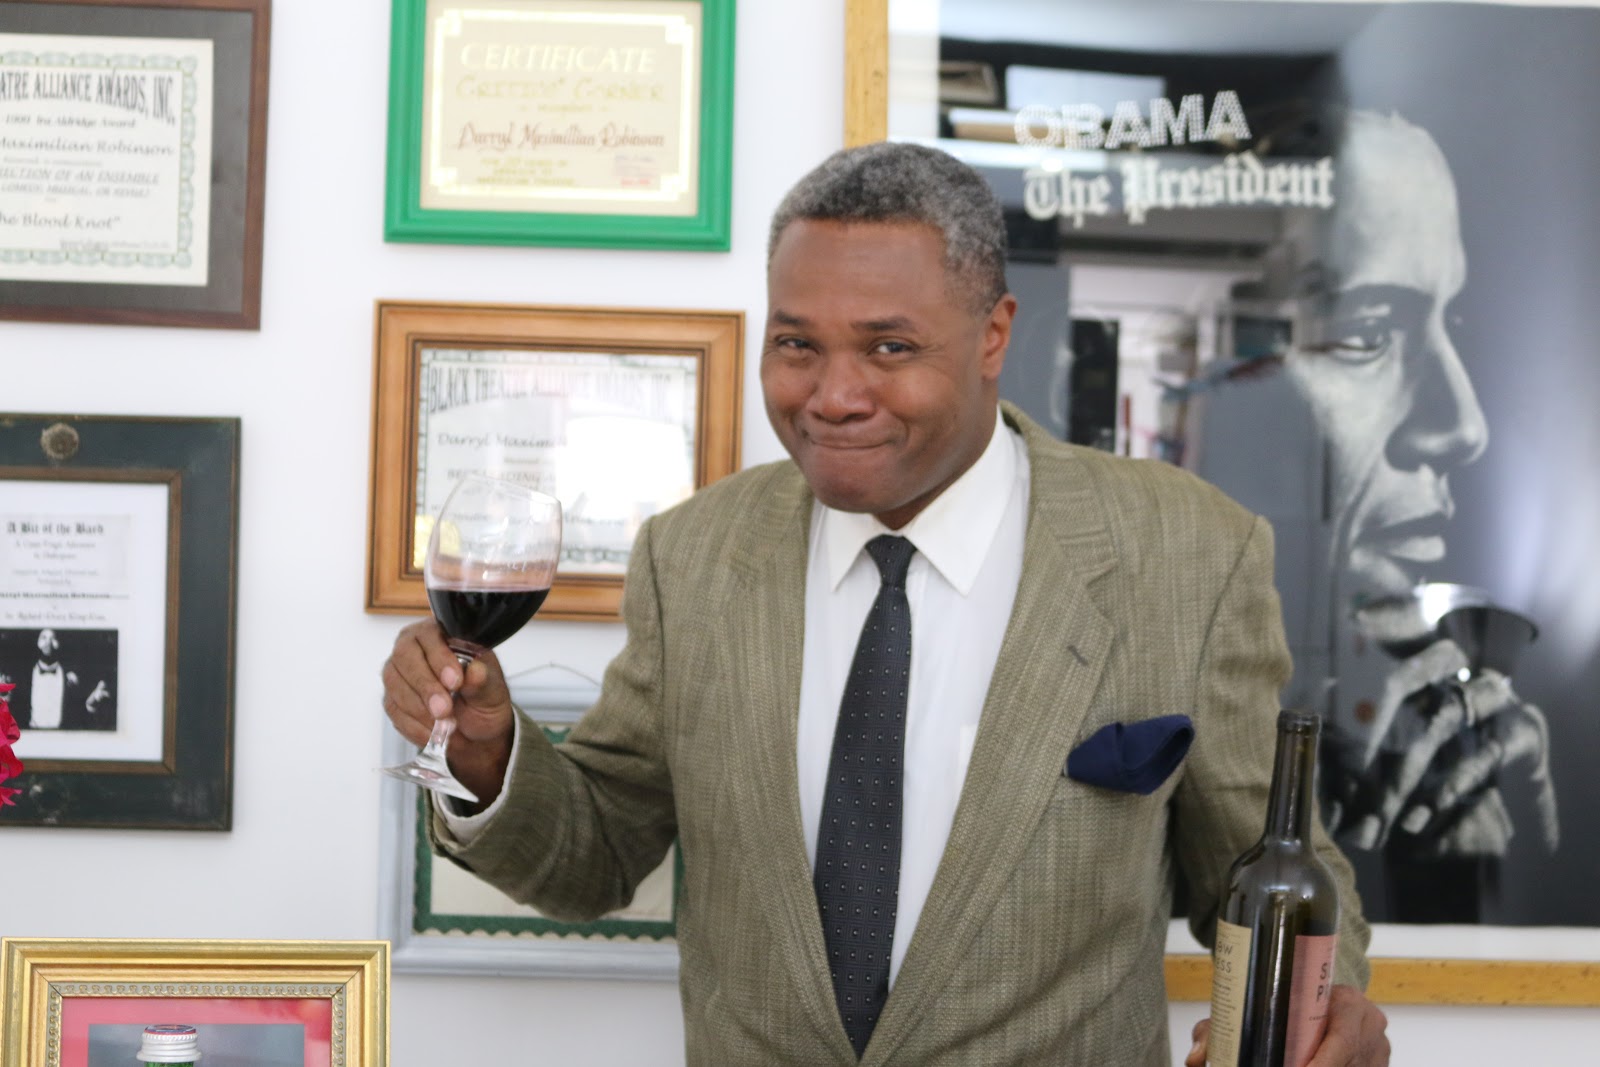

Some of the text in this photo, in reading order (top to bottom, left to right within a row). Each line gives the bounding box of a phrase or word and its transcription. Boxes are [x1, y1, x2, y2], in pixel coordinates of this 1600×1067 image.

[459, 43, 656, 74] CERTIFICATE
[33, 72, 92, 103] ALLIANCE
[95, 68, 149, 119] AWARDS,
[1013, 89, 1252, 150] OBAMA
[97, 138, 174, 157] Robinson
[458, 120, 516, 152] Darryl
[97, 170, 160, 186] ENSEMBLE
[1023, 149, 1335, 229] The President
[22, 211, 69, 229] Blood
[430, 366, 470, 414] BLACK
[437, 432, 490, 450] Darryl
